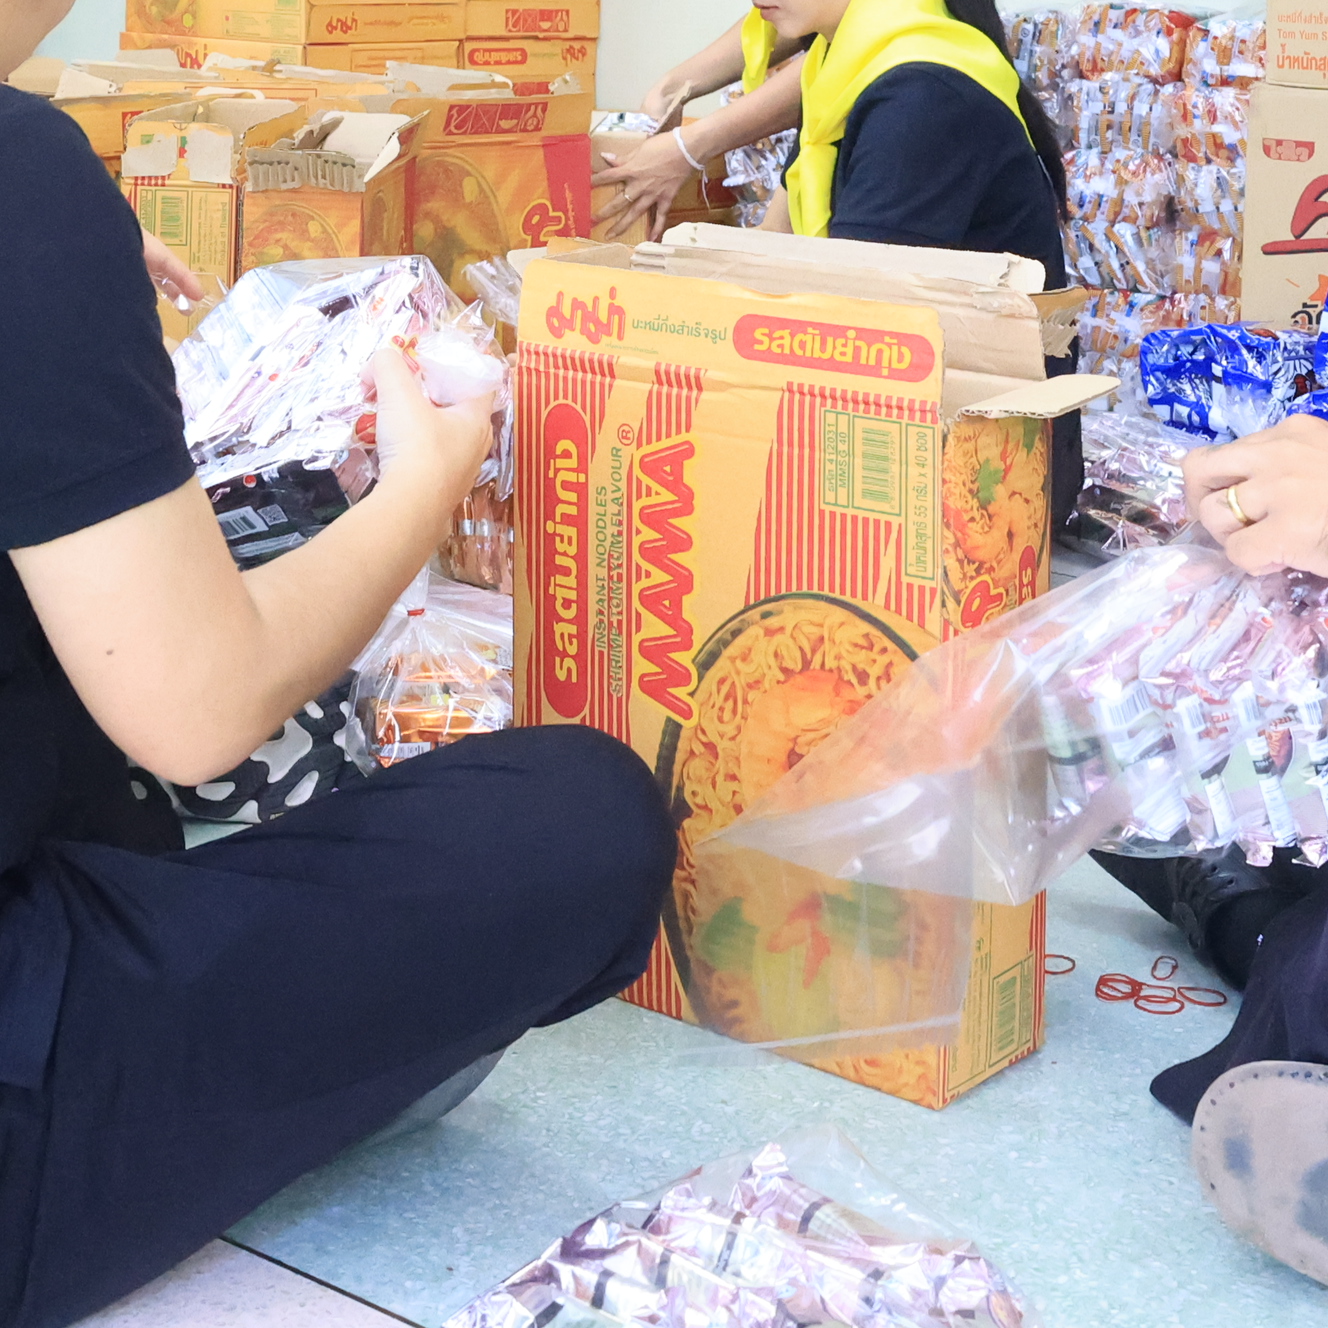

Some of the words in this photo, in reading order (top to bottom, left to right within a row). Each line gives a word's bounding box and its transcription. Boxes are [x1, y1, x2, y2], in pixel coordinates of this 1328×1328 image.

[1277, 28, 1296, 40] Tom
[1299, 29, 1319, 41] Yum
[545, 285, 626, 345] มาม่า
[752, 326, 913, 370] รสต้มยำกุ้ง
[826, 422, 836, 465] 412031
[838, 431, 848, 446] 40
[915, 431, 928, 453] ซอง
[838, 449, 848, 489] MMSG
[913, 455, 927, 469] 40
[610, 446, 624, 529] FLAVOUR
[912, 481, 928, 502] กรัม
[595, 485, 608, 570] NOODLES
[913, 504, 928, 519] 55
[545, 438, 586, 684] รสต้มยำกุ้ง
[610, 532, 624, 576] YUM
[610, 579, 624, 621] TOM
[637, 440, 695, 722] MAMA
[595, 573, 608, 652] INSTANT
[610, 624, 624, 698] SHRIMP
